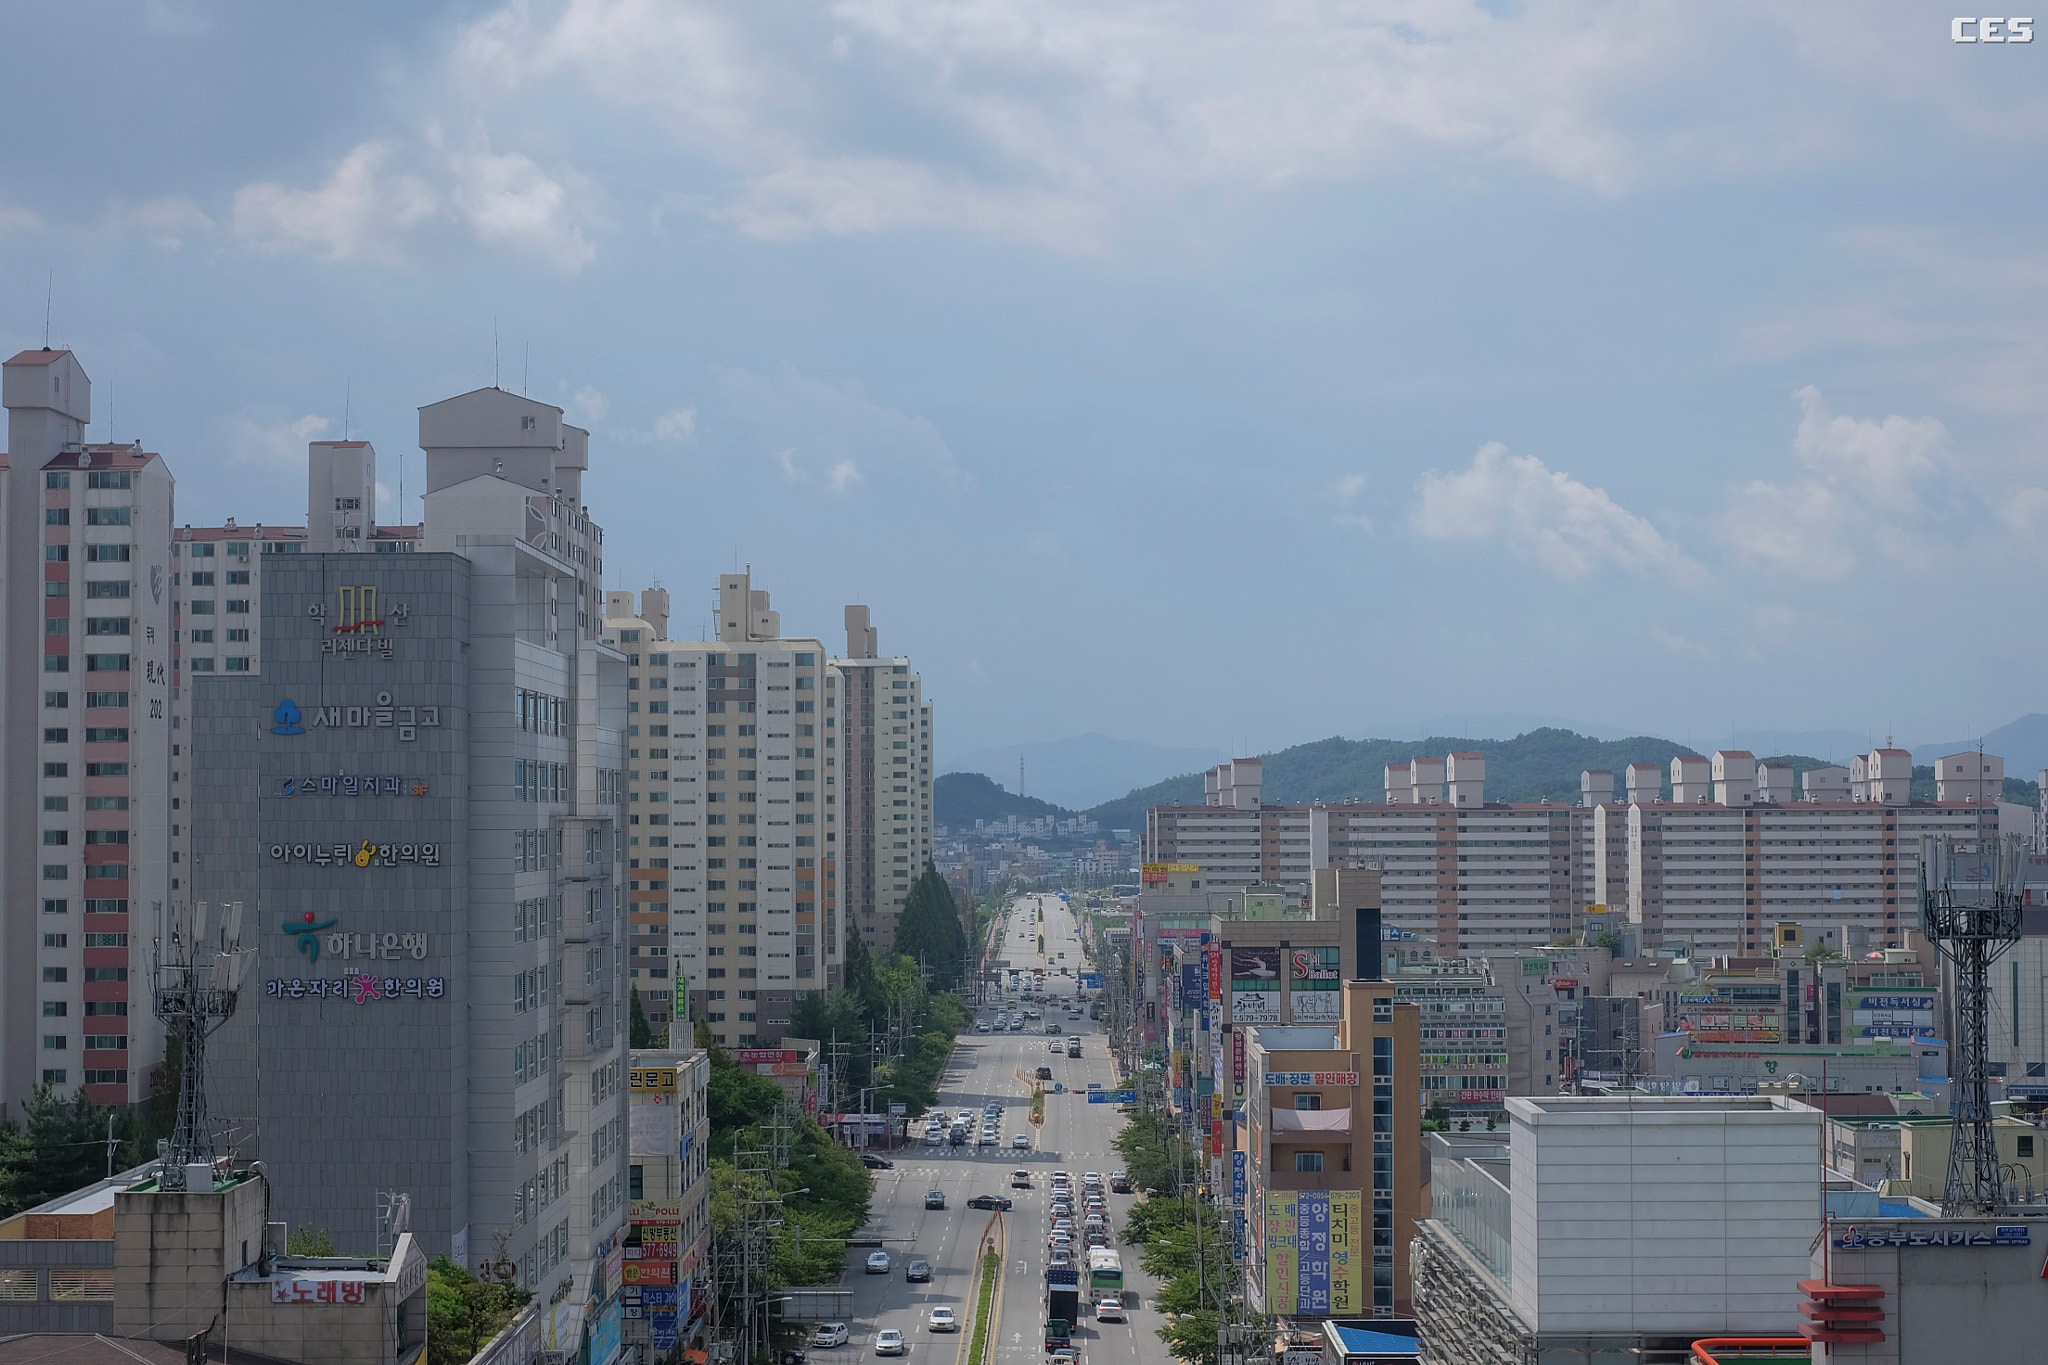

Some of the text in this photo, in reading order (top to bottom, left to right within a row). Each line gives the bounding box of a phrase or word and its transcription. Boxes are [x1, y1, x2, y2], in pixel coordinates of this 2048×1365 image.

[307, 602, 410, 626] 학 산
[146, 660, 166, 685] 現代
[150, 698, 162, 719] 202
[312, 690, 441, 741] 새마을금고
[301, 775, 402, 796] 스마일치과
[270, 843, 440, 867] 아이누리 한의원
[326, 932, 428, 960] 하나은행
[1308, 969, 1338, 980] Ballet
[266, 978, 444, 998] 가온자리 한의원
[1868, 998, 1921, 1008] 비전독서실
[1870, 1028, 1920, 1037] 비전독서실
[1764, 1060, 1778, 1074] 향
[630, 1072, 674, 1087] 린문고
[1265, 1073, 1358, 1085] 도배·장판 할인매장
[1461, 1091, 1472, 1099] 간판
[1234, 1154, 1244, 1204] 양정학원
[656, 1208, 680, 1216] POLLI
[1268, 1204, 1296, 1217] 도배
[642, 1228, 677, 1241] 신방부동산
[1268, 1220, 1297, 1233] 장판
[1267, 1235, 1296, 1249] 씽크대
[1867, 1230, 1991, 1247] 중부도시가스
[1350, 1239, 1359, 1256] 전문
[1312, 1203, 1328, 1309] 양정학원
[1332, 1204, 1350, 1310] 티치미 영수학원
[626, 1269, 638, 1278] 밝은
[640, 1267, 670, 1278] 한의원
[1276, 1253, 1290, 1309] 할인시공
[292, 1281, 364, 1303] 노래방
[630, 1287, 638, 1295] 기
[630, 1308, 638, 1316] 장
